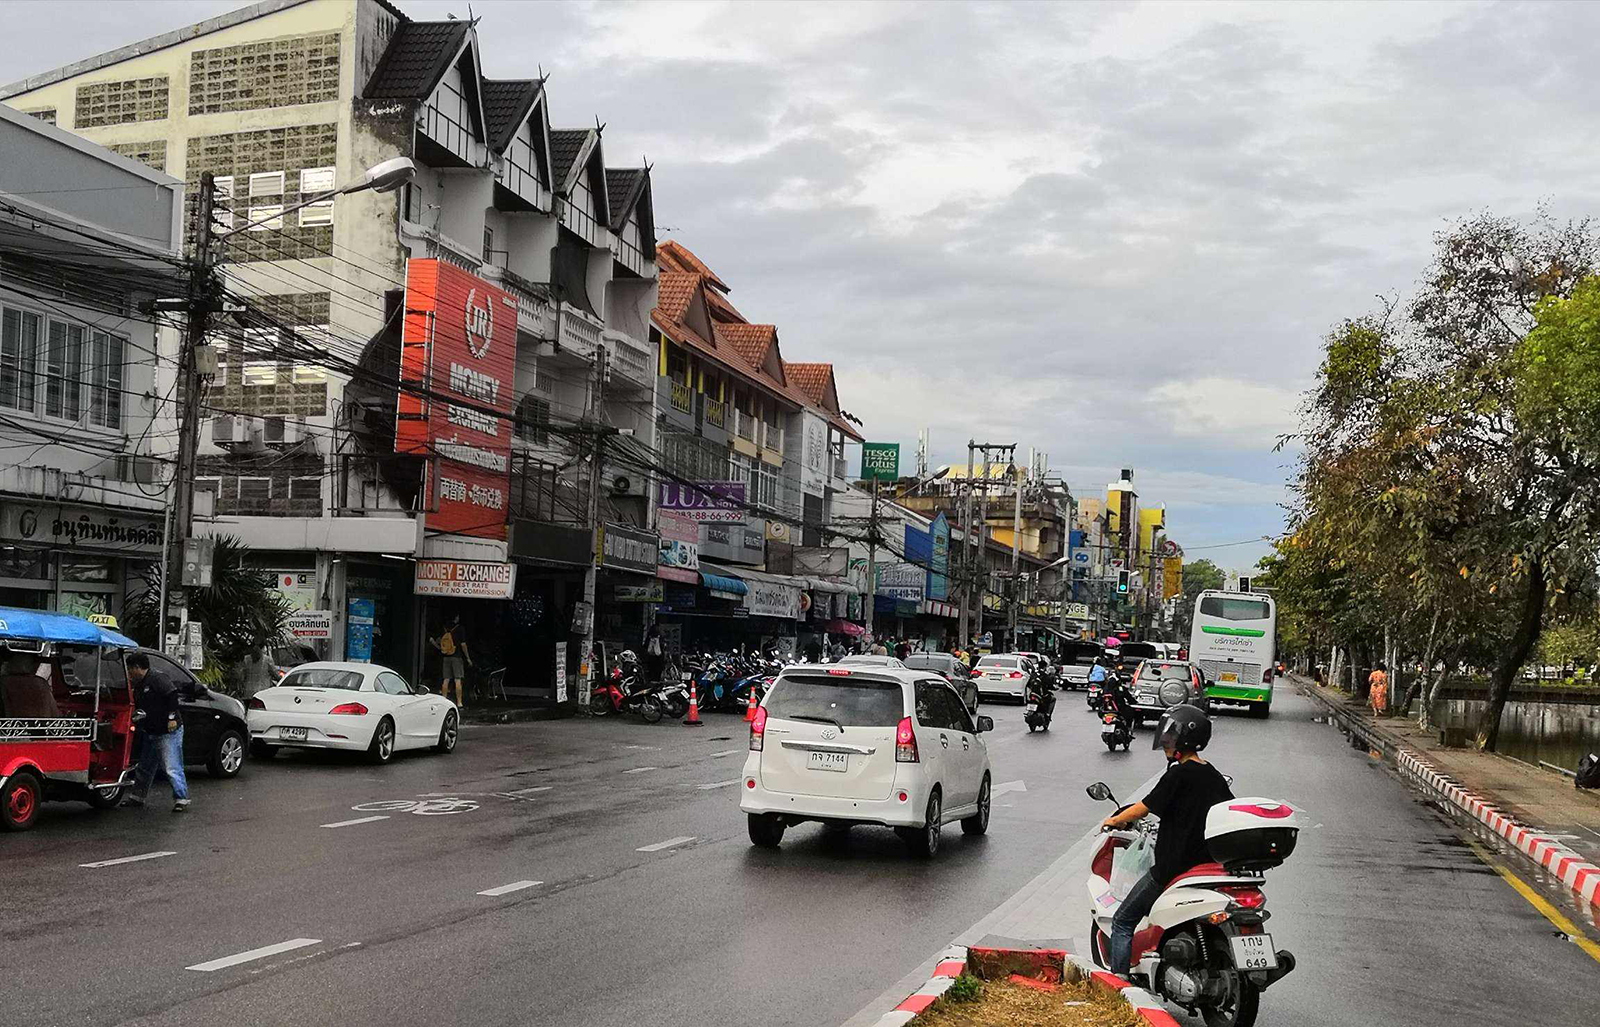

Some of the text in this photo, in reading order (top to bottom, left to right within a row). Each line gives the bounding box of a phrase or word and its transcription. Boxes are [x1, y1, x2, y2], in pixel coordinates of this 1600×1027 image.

[449, 361, 500, 405] MONEY
[864, 449, 897, 458] TESCO
[865, 457, 896, 469] Lotus
[418, 562, 511, 583] MONEY EXCHANGE
[462, 588, 507, 596] COMMISSION
[91, 616, 111, 624] TAXI
[826, 753, 845, 763] 7144
[1246, 957, 1268, 968] 649
